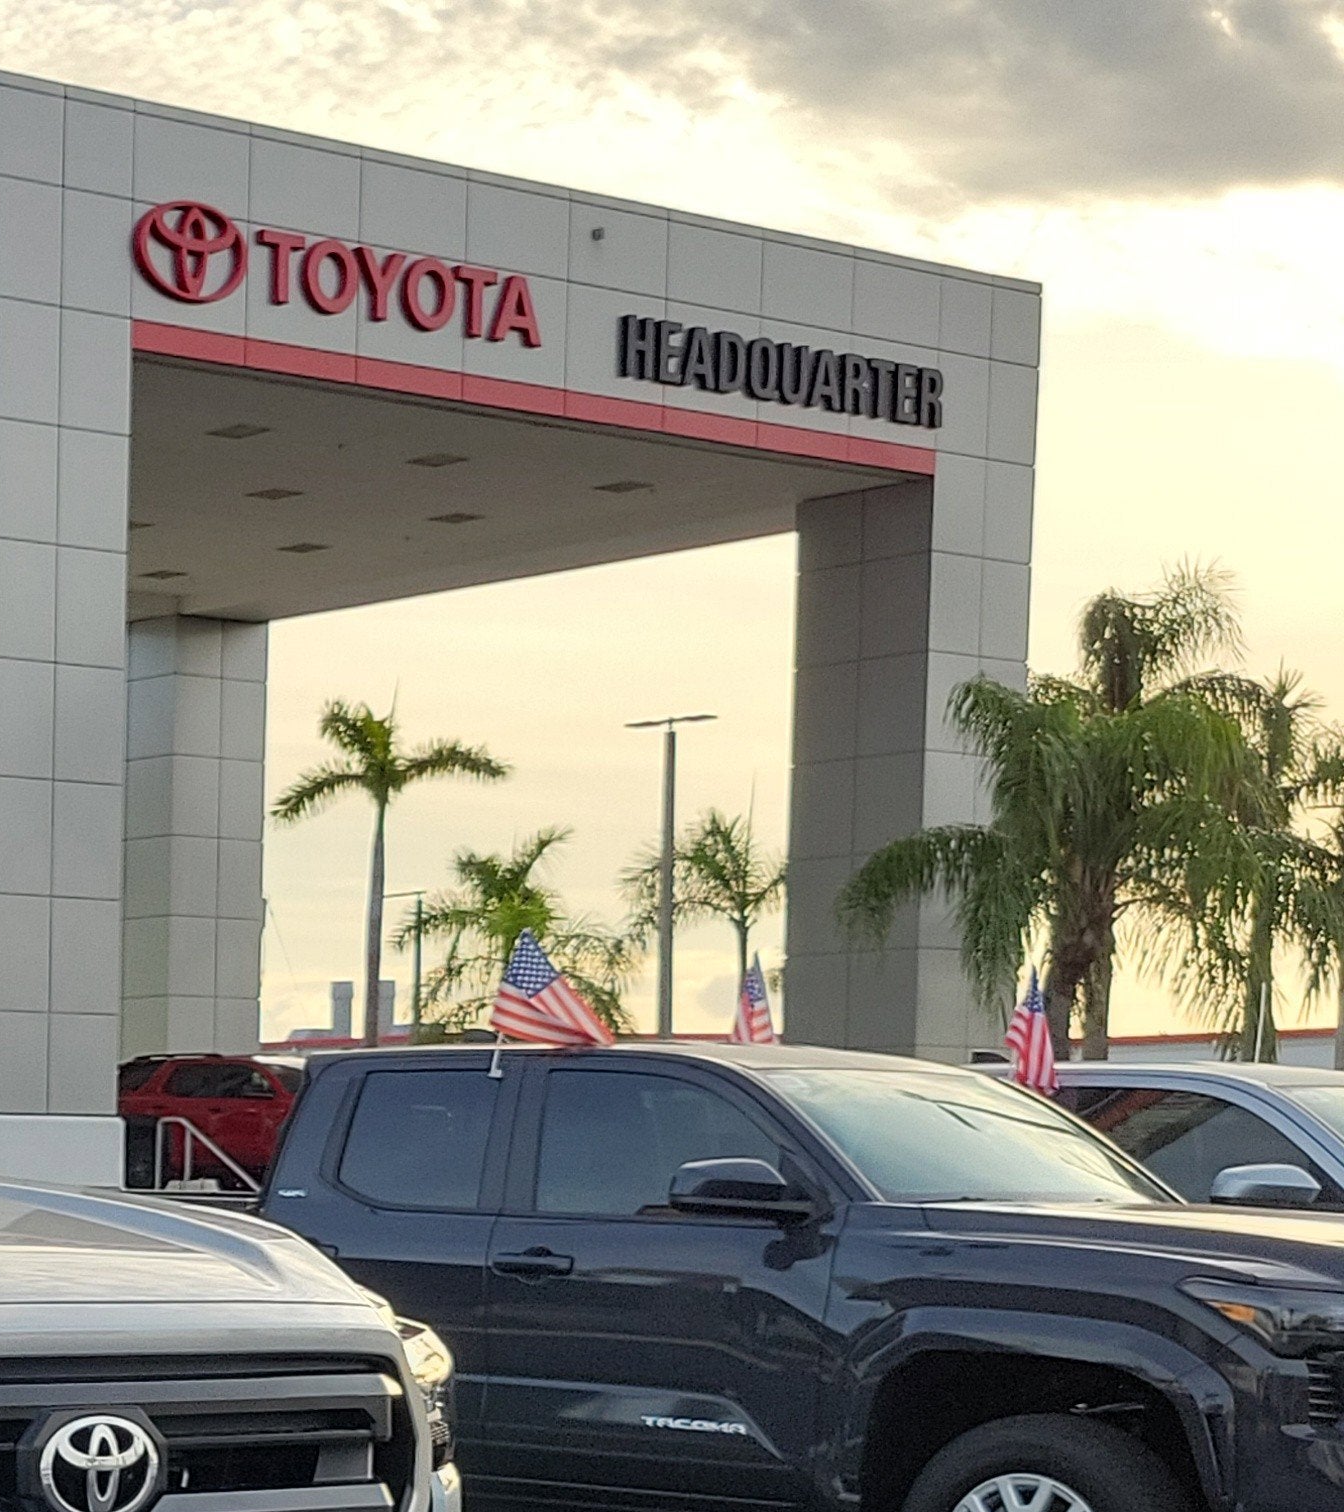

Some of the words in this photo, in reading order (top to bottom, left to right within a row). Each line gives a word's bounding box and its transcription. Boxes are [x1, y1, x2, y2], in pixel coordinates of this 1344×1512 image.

[256, 227, 542, 349] TOYOTA
[617, 314, 944, 429] HEADQUARTER
[640, 1415, 748, 1436] TACOMA
